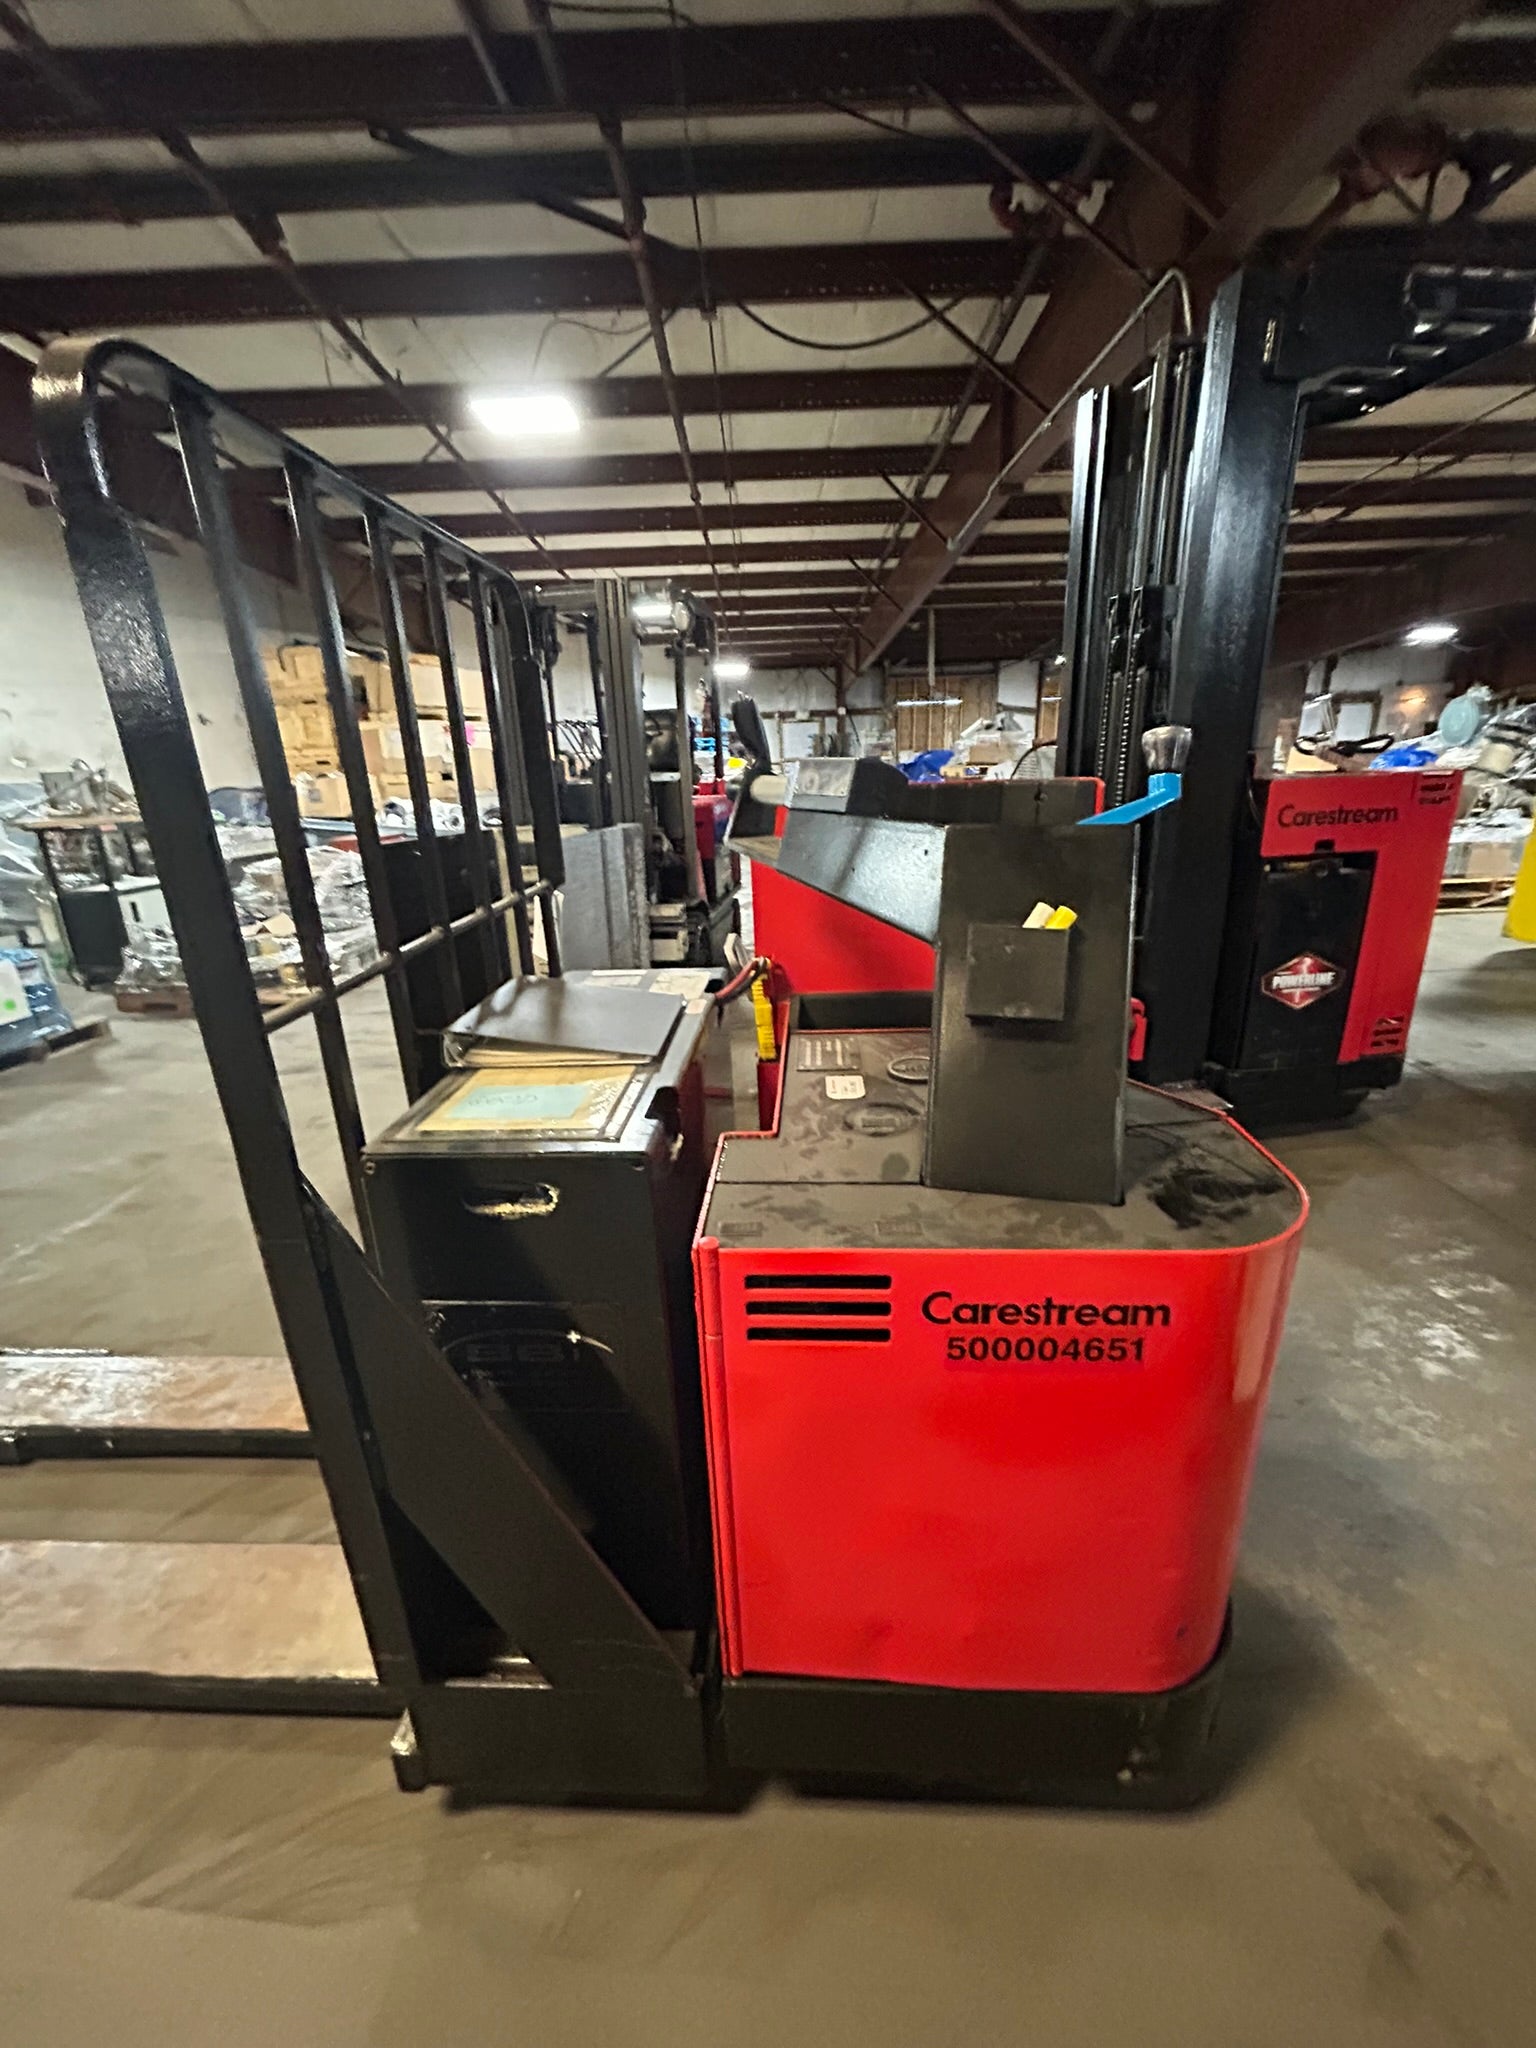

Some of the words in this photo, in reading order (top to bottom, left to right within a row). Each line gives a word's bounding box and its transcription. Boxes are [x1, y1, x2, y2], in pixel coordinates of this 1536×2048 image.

[1277, 802, 1399, 829] Carestream
[921, 1291, 1171, 1326] Carestream
[947, 1336, 1145, 1362] 500004651
